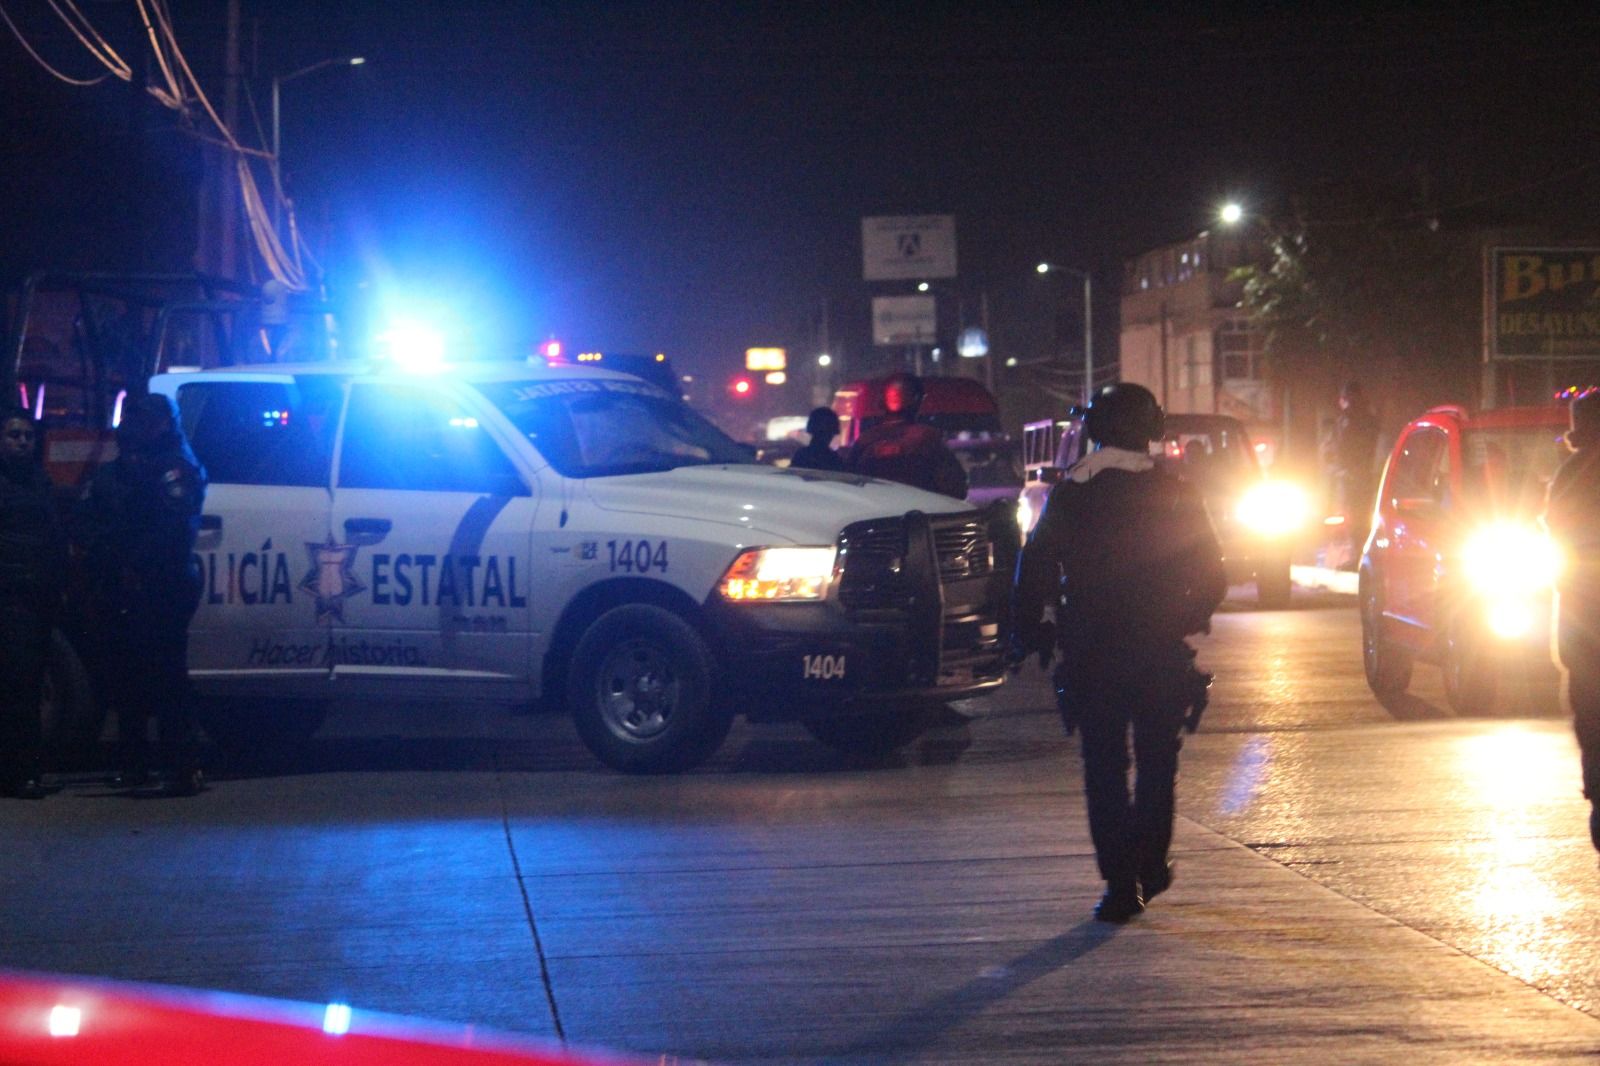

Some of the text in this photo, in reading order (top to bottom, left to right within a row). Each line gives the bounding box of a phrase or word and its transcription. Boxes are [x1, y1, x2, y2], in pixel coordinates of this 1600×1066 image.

[606, 540, 669, 573] 1404
[372, 553, 527, 608] ESTATAL
[249, 637, 323, 667] Hacer
[803, 654, 846, 679] 1404
